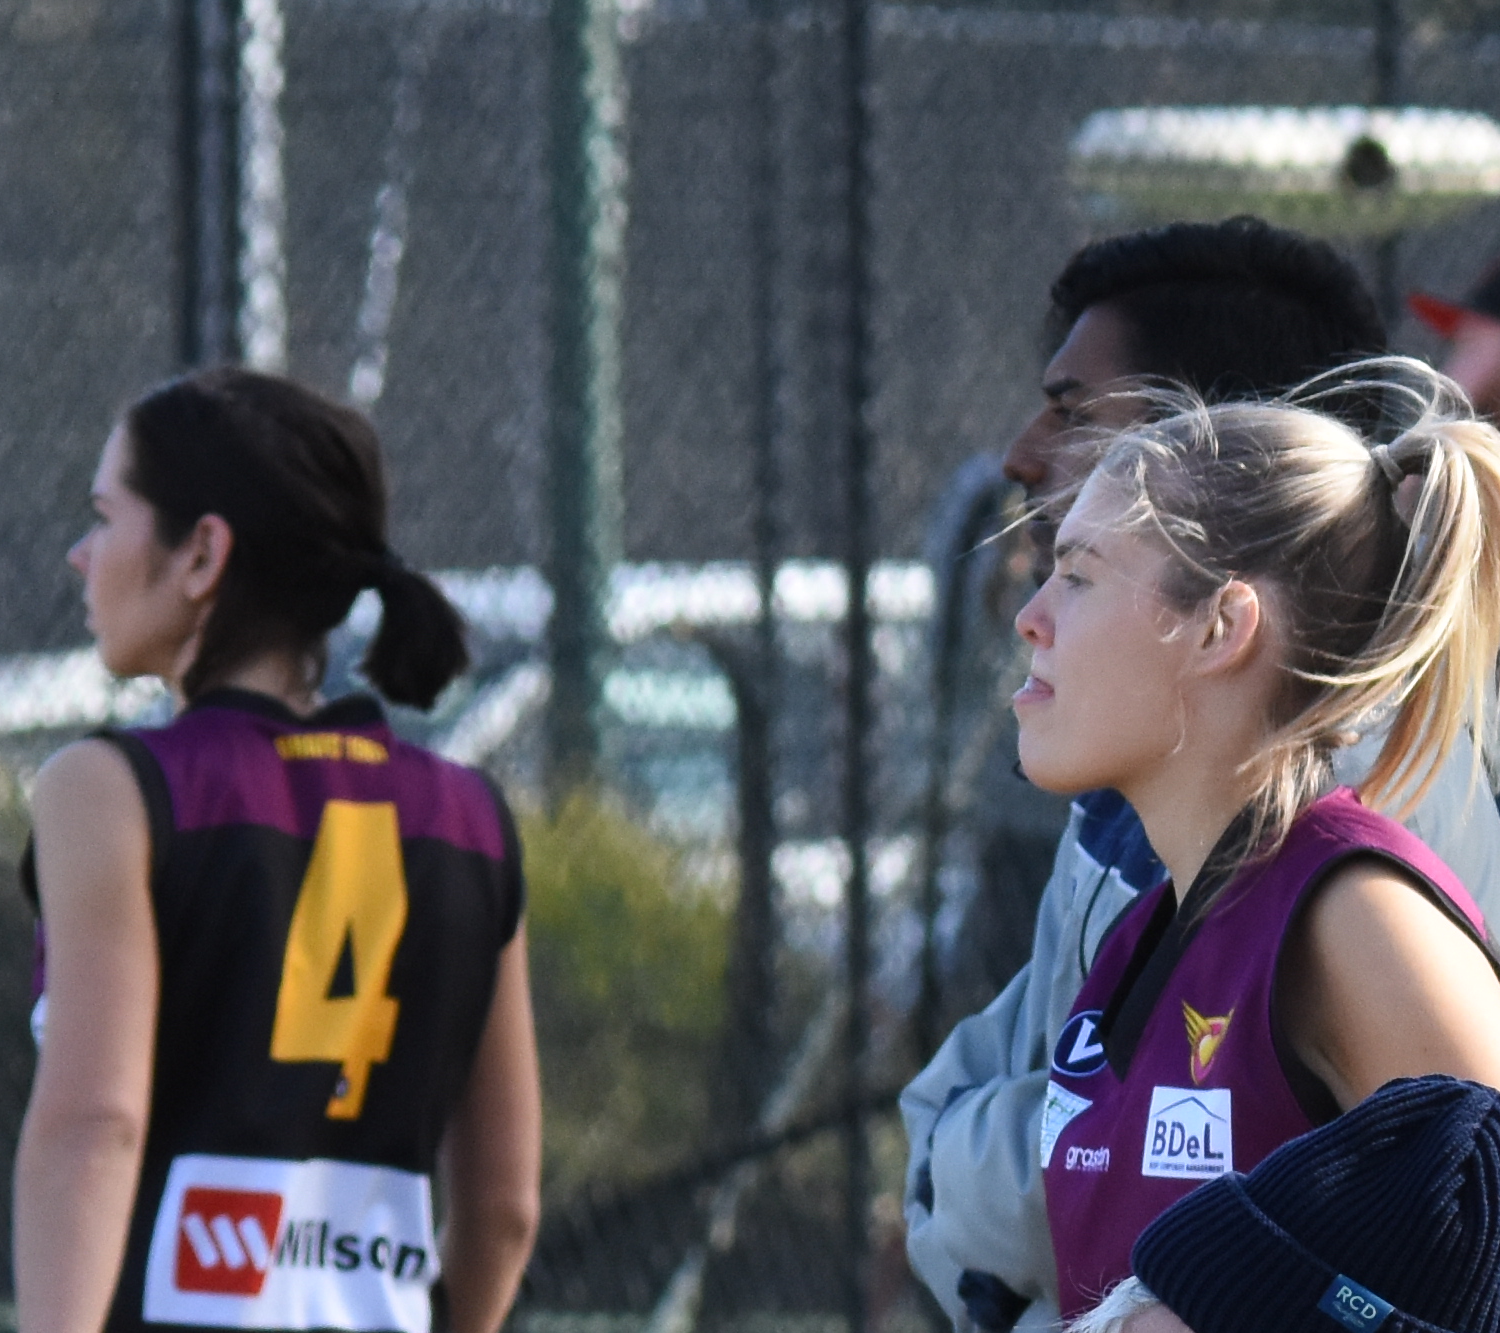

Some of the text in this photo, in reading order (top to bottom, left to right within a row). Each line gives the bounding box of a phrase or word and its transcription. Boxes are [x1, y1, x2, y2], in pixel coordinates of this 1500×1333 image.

[270, 801, 407, 1120] 4
[1152, 1120, 1224, 1160] BDeL
[1336, 1285, 1376, 1319] RCD
